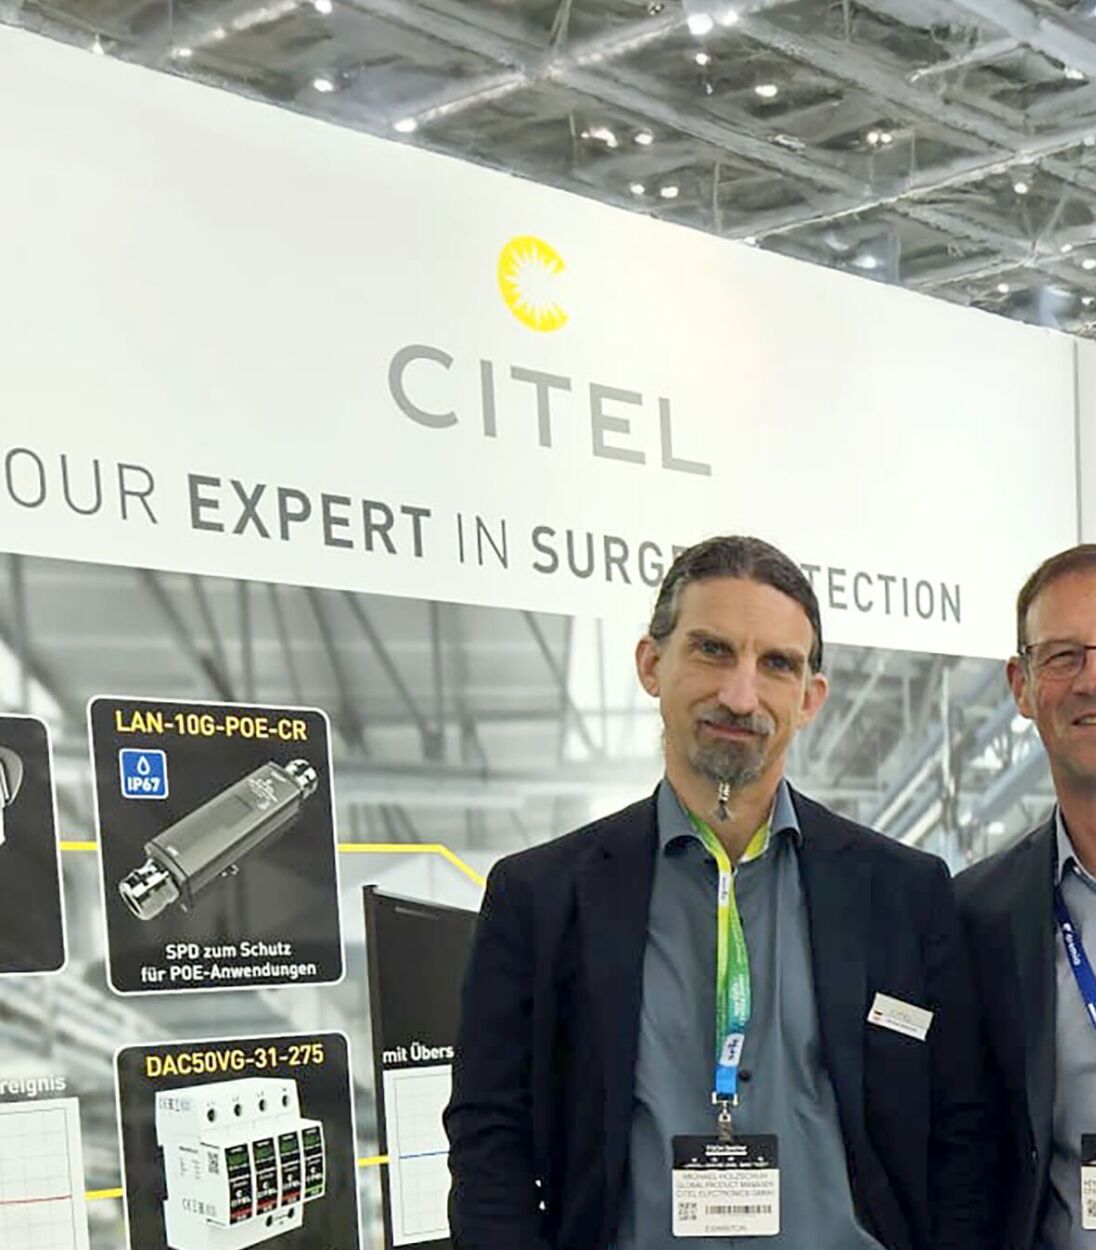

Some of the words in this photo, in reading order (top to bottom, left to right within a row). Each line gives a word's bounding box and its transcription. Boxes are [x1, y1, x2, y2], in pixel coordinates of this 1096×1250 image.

[388, 344, 712, 476] CITEL
[187, 472, 432, 558] EXPERT
[456, 513, 509, 570] IN
[531, 525, 689, 588] SURG
[115, 710, 307, 740] LAN-10G-POE-CR
[127, 777, 161, 792] IP67
[165, 944, 199, 960] SPD
[203, 945, 237, 959] zum
[240, 942, 292, 957] Schutz
[141, 967, 166, 982] für
[170, 962, 317, 981] POE-Anwendungen
[146, 1044, 324, 1077] DAC50VG-31-275
[383, 1046, 407, 1063] mit
[410, 1041, 454, 1060] Übers
